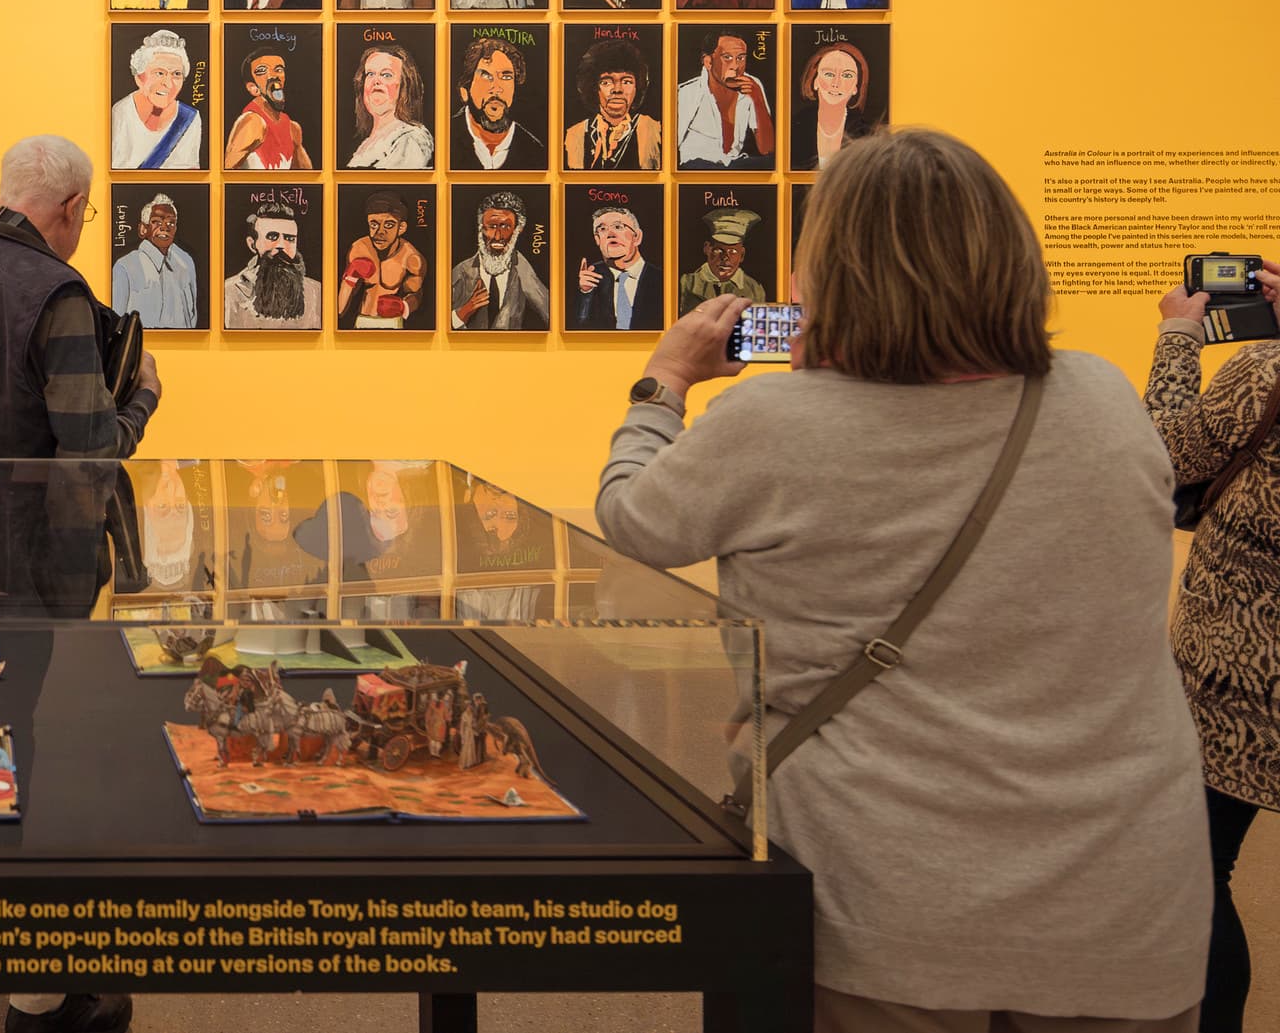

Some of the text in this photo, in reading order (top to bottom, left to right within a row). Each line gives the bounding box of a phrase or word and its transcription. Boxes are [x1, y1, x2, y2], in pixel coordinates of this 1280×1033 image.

[1205, 177, 1231, 185] People
[1214, 186, 1243, 194] painted
[30, 904, 69, 918] one
[73, 900, 94, 918] of
[99, 900, 132, 918] the
[137, 900, 200, 921] family
[204, 900, 305, 921] alongside
[308, 899, 363, 921] Tony,
[367, 899, 398, 918] his
[403, 900, 467, 918] studio
[471, 901, 529, 920] team,
[534, 900, 564, 918] his
[569, 900, 633, 918] studio
[637, 900, 677, 921] dog
[36, 932, 111, 949] pop-up
[115, 927, 179, 946] books
[183, 927, 205, 946] of
[209, 927, 243, 945] the
[248, 927, 318, 946] British
[323, 927, 376, 948] royal
[380, 927, 445, 948] family
[450, 927, 491, 945] that
[496, 927, 547, 948] Tony
[551, 926, 590, 944] had
[595, 925, 682, 944] sourced
